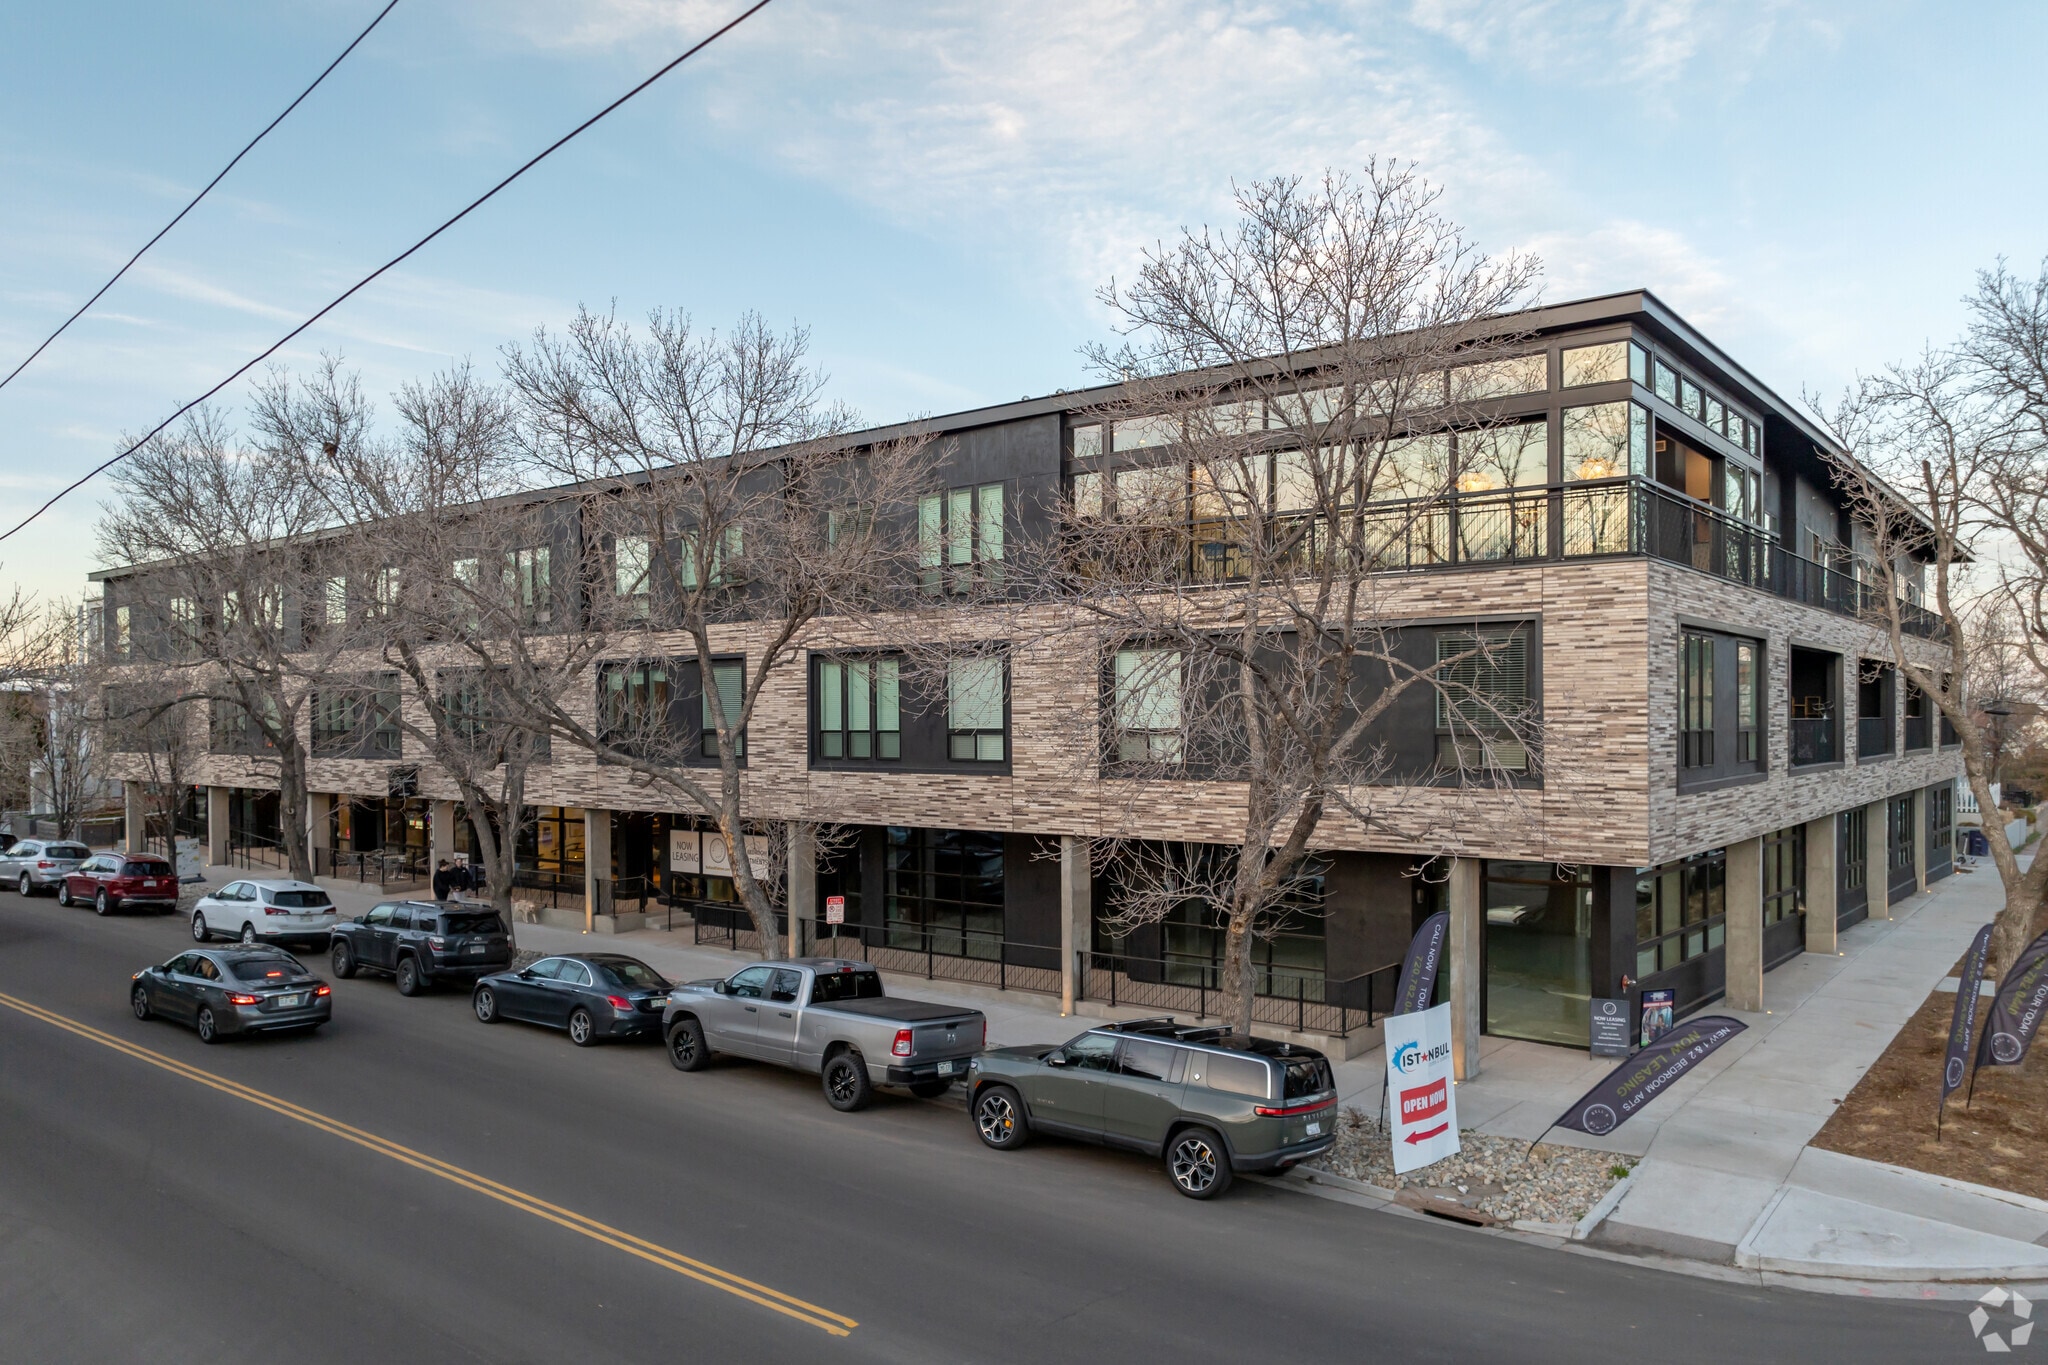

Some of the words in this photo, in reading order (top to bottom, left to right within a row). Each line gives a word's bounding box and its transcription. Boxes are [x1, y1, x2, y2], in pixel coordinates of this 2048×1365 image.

[672, 851, 699, 863] LEASING
[676, 841, 693, 851] NOW
[1430, 924, 1442, 946] CALL
[1425, 948, 1436, 972] NOW
[2030, 984, 2048, 1007] TOUR
[2018, 1008, 2038, 1036] TODAY
[1670, 1030, 1701, 1056] NOW
[1709, 1026, 1731, 1044] NEW
[1687, 1051, 1697, 1060] 2
[1616, 1054, 1668, 1097] LEASING
[1645, 1057, 1689, 1094] BEDROOM
[1403, 1095, 1428, 1114] OPEN
[1429, 1087, 1445, 1107] NOW
[1622, 1090, 1645, 1112] APTS
